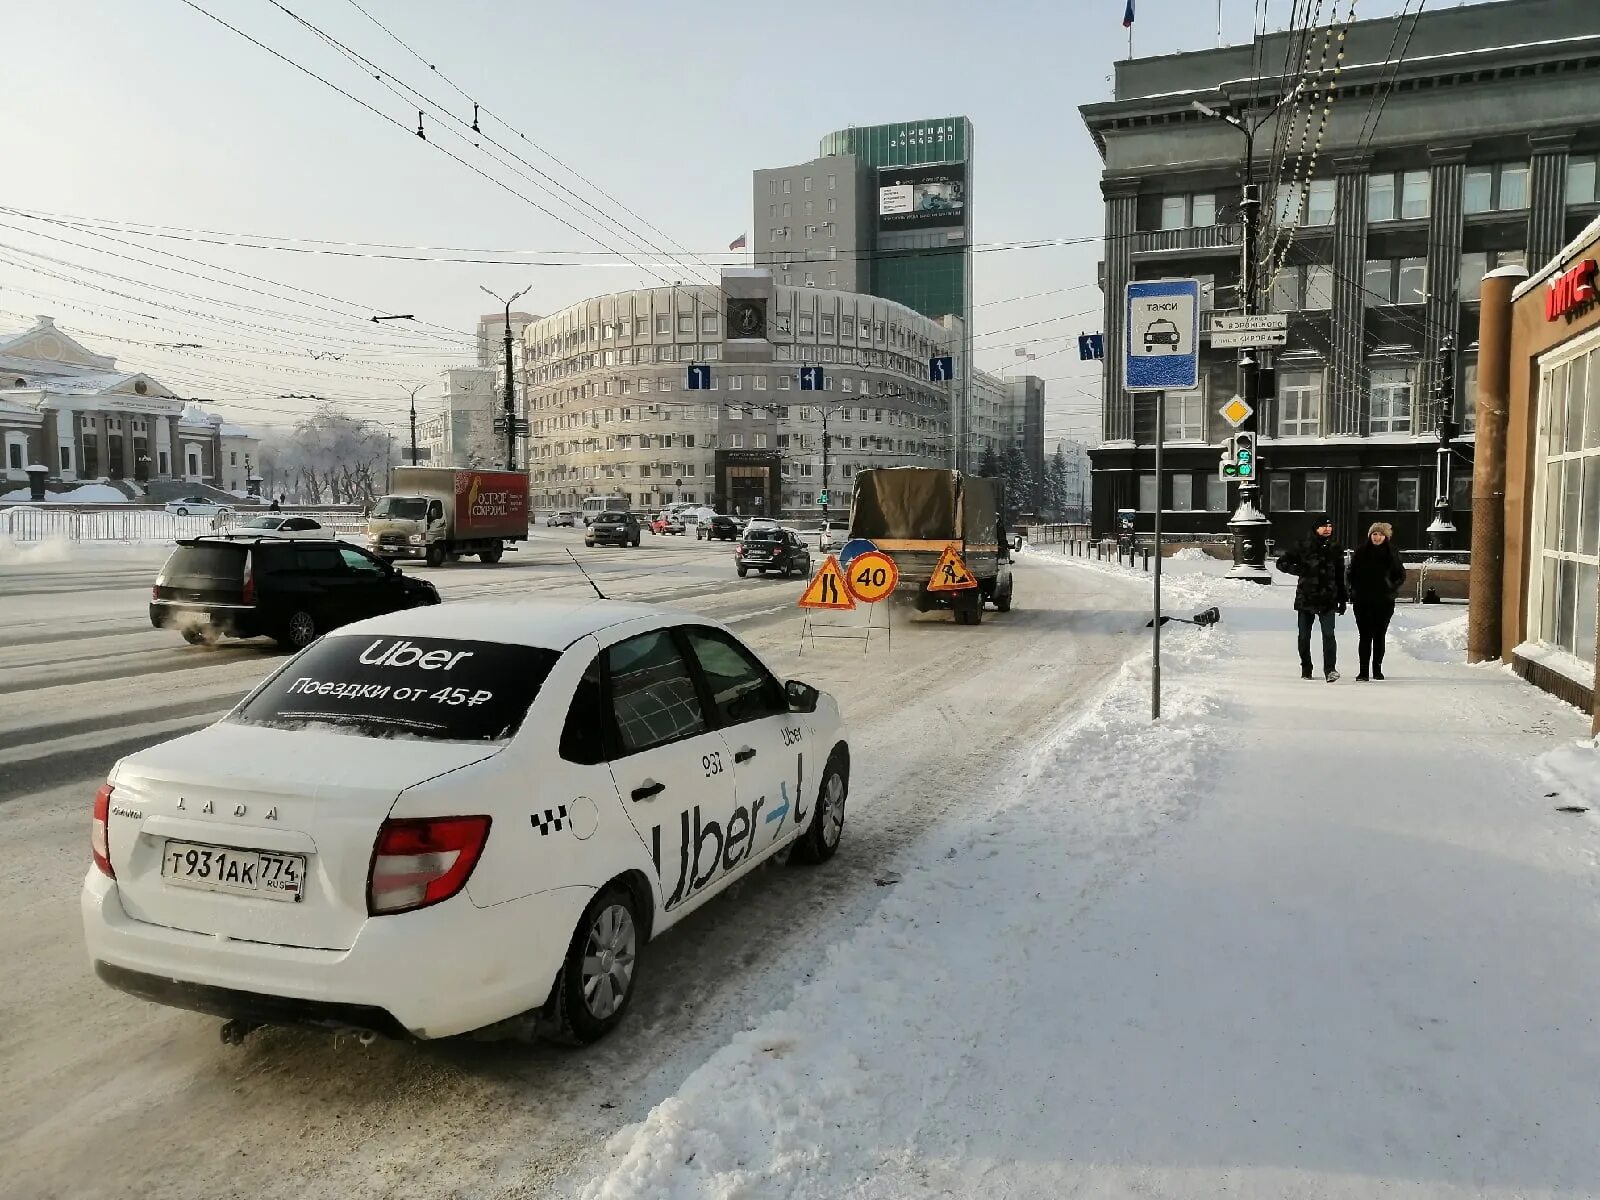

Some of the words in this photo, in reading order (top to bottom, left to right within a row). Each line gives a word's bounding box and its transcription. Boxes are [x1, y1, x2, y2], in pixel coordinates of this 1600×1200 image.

[857, 567, 887, 588] 40
[359, 639, 474, 671] Uber
[286, 676, 392, 699] Поездки
[392, 687, 428, 701] от
[780, 726, 803, 747] Uber
[702, 751, 724, 778] 931
[176, 797, 278, 821] LADA
[652, 795, 765, 913] Uber
[266, 879, 285, 890] RUS
